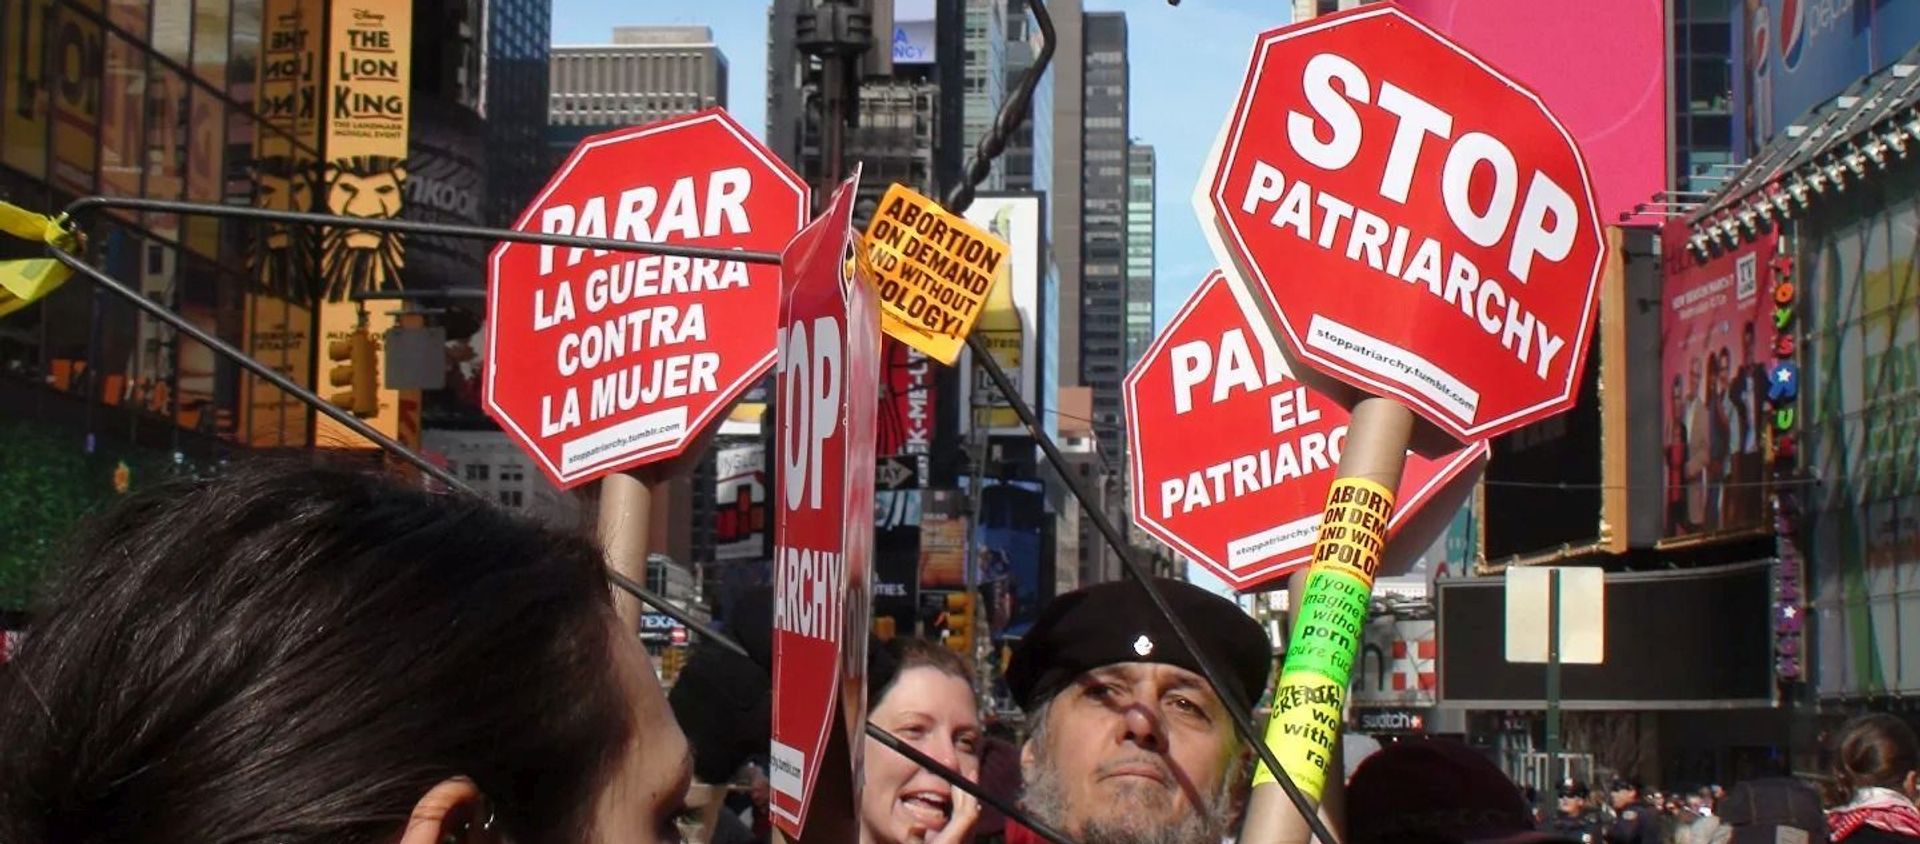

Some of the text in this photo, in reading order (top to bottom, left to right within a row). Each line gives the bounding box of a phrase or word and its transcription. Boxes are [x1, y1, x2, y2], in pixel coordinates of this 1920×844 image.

[347, 30, 390, 48] THE
[340, 51, 398, 81] LION
[334, 85, 403, 119] KING
[1286, 52, 1579, 285] STOP
[539, 166, 752, 276] PARAR
[883, 196, 1003, 275] ABORTION
[873, 220, 989, 297] ON DEMAND
[1241, 160, 1566, 381] PATRIARCHY
[533, 248, 749, 331] LA GUERRA
[899, 261, 978, 317] WITHOUT
[557, 304, 708, 377] CONTRA
[541, 352, 720, 438] LA MUJER
[1315, 327, 1477, 413] stoppatriarchy.tumblr.com
[1270, 386, 1322, 434] EL
[568, 421, 681, 464] stoppatriarchy.tumblr.com
[1324, 507, 1347, 525] ON
[1329, 485, 1394, 525] ABORT
[1319, 526, 1347, 543] AND
[1314, 543, 1379, 583] APOLO
[1321, 579, 1355, 596] you
[774, 546, 841, 643] ARCHY
[1361, 711, 1410, 728] swatch
